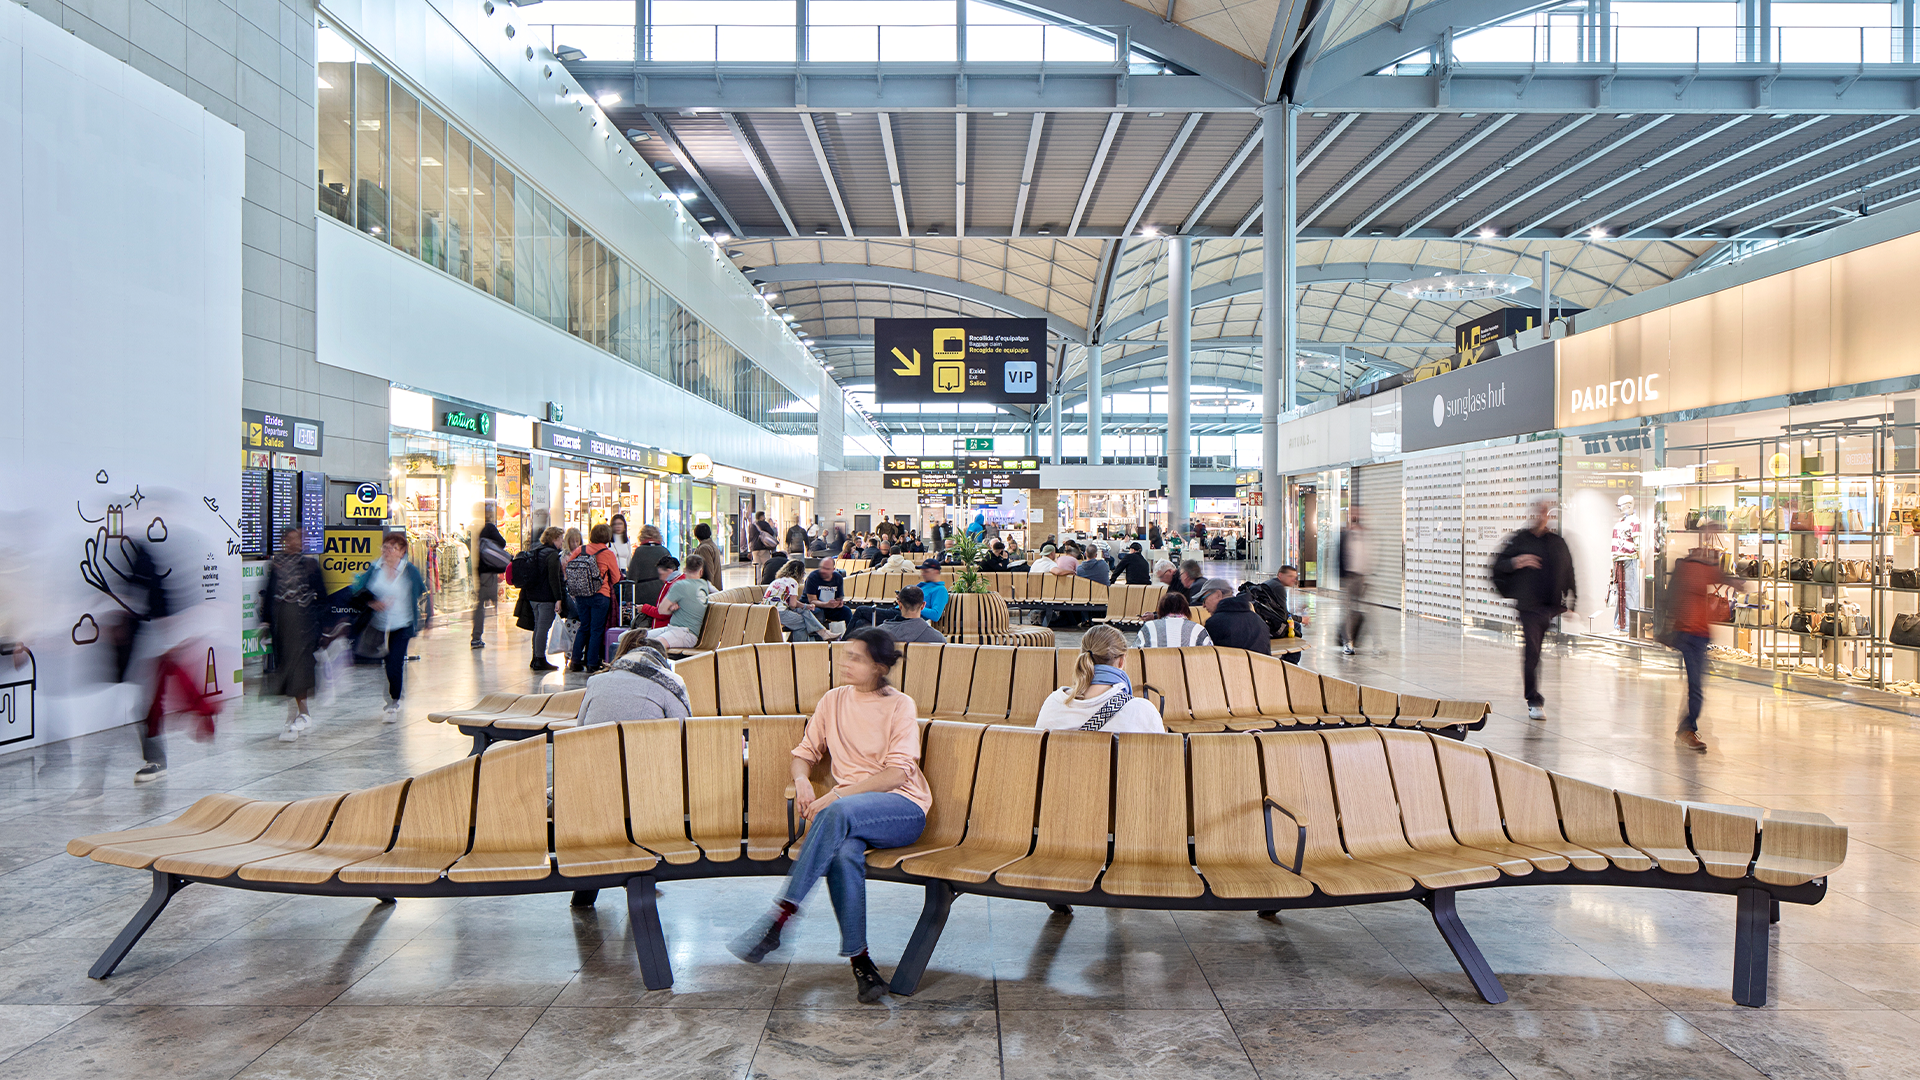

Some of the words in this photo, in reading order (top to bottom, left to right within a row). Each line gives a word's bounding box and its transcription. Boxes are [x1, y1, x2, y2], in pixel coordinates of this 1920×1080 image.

[1008, 371, 1033, 383] VIP
[1446, 388, 1486, 422] sunglass
[1488, 381, 1506, 409] hut
[1571, 373, 1660, 414] PARFOIS
[264, 415, 283, 426] Eixides
[447, 411, 477, 431] natura
[264, 426, 288, 437] Departures
[264, 436, 284, 448] Salidas
[590, 440, 605, 454] FRESH
[605, 443, 626, 459] BAGUETTES
[631, 449, 641, 462] GIFTS
[353, 506, 381, 516] ATM
[325, 537, 371, 553] ATM
[323, 558, 372, 574] Cajero
[248, 637, 258, 653] MIN
